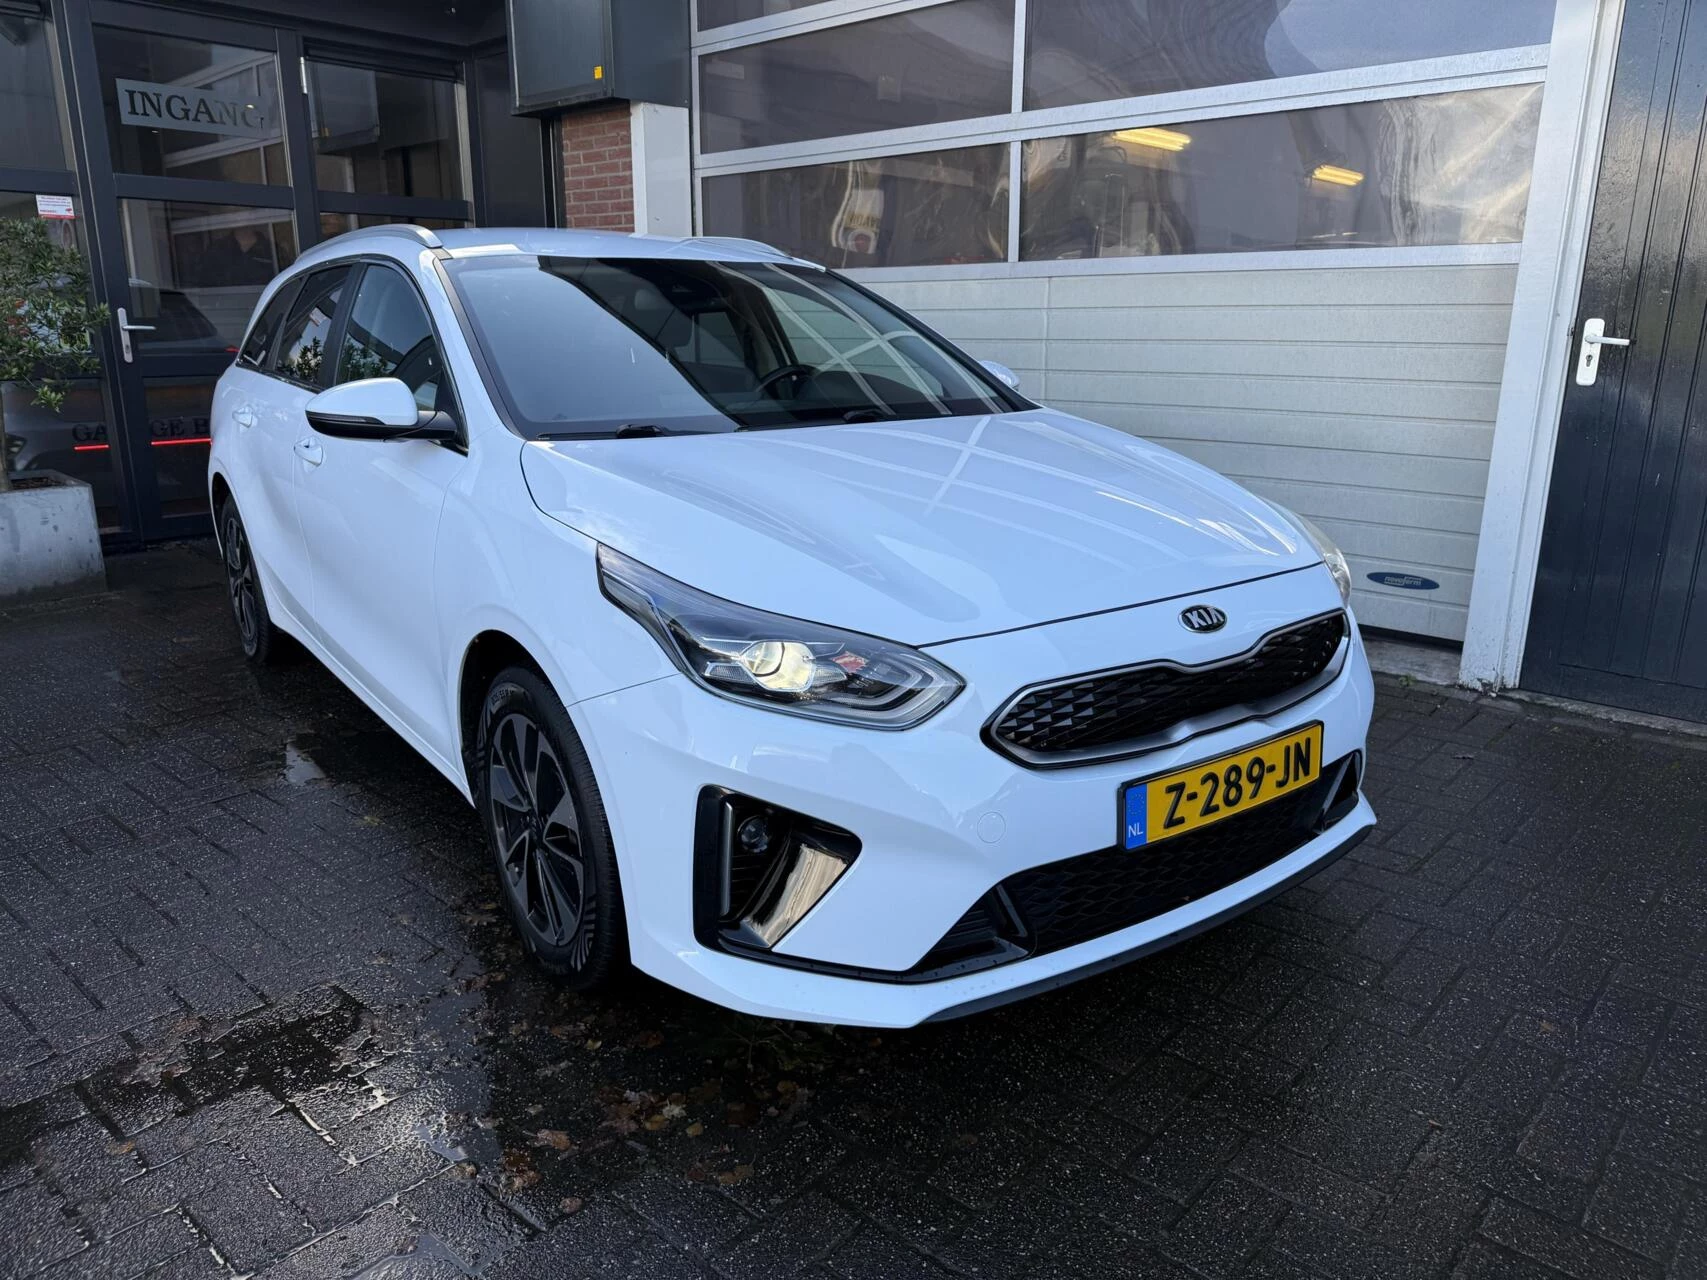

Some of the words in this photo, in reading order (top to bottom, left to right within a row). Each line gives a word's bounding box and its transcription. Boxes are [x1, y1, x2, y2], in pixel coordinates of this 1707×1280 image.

[124, 89, 265, 129] INGANG
[1184, 606, 1225, 629] KIA
[1163, 737, 1311, 829] Z-289-JN
[1128, 823, 1144, 838] NL
